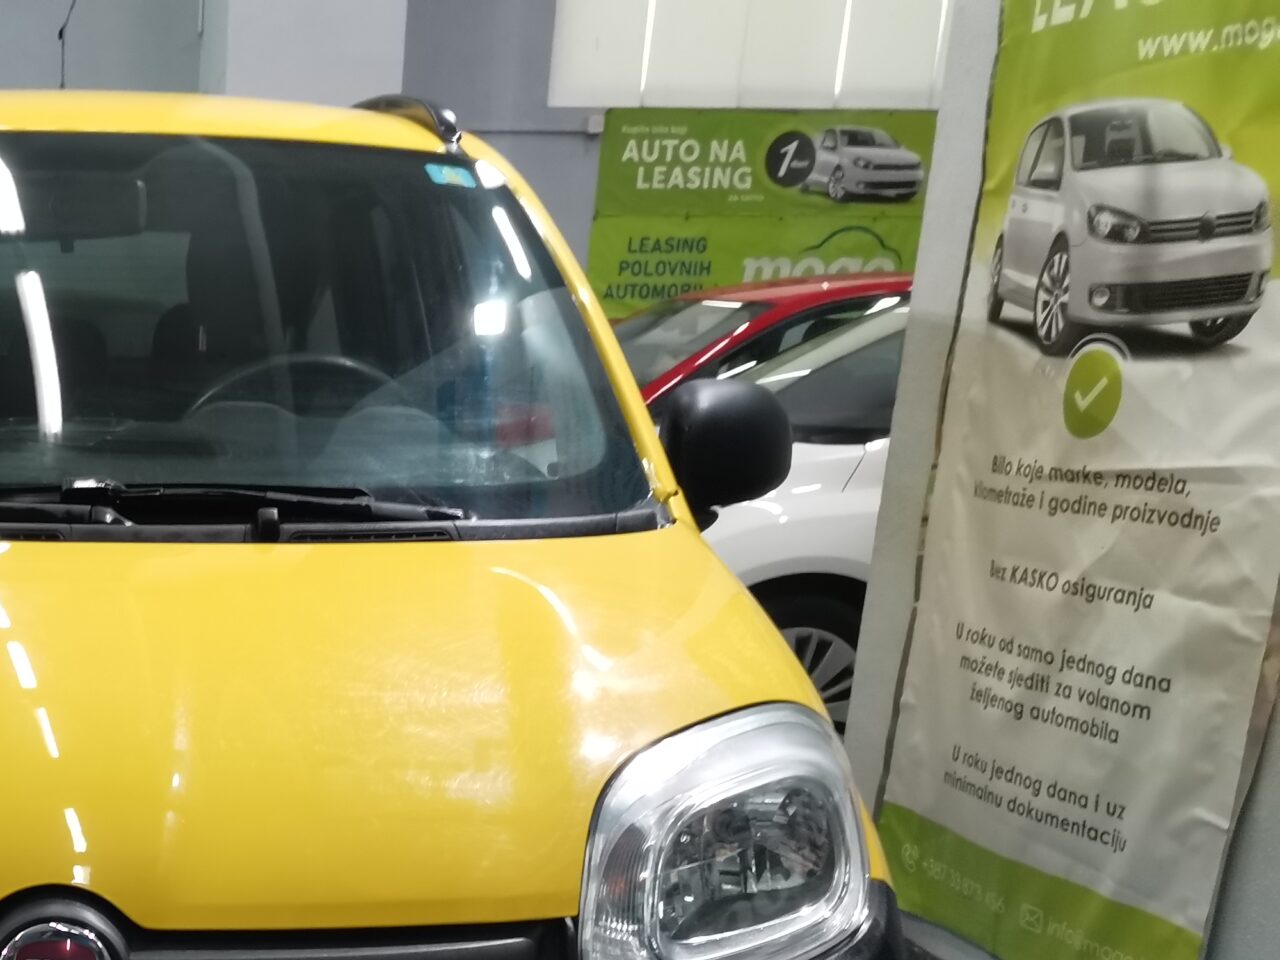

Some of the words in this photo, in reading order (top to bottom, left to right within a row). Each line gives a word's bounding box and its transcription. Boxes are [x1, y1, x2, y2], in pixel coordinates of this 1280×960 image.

[1137, 16, 1280, 61] www.mog
[621, 138, 701, 163] AUTO
[708, 138, 747, 163] NA
[777, 139, 800, 179] 1
[636, 165, 754, 190] LEASING
[627, 236, 708, 254] LEASING
[618, 260, 712, 277] POLOVNIH
[1015, 457, 1044, 484] koje
[1048, 465, 1109, 489] marke,
[1114, 471, 1191, 499] modela,
[1039, 490, 1046, 510] i
[1048, 494, 1108, 517] godine
[1110, 501, 1222, 538] proizvodnje
[1010, 564, 1059, 592] KASKO
[1061, 577, 1155, 613] osiguranja
[956, 622, 965, 640] U
[965, 627, 996, 649] roku
[999, 636, 1015, 655] od
[1017, 643, 1055, 665] samo
[1058, 648, 1117, 686] jednog
[1121, 665, 1172, 693] dana
[960, 655, 1006, 682] možete
[1007, 666, 1051, 693] sjediti
[1054, 682, 1072, 699] za
[1078, 687, 1152, 721] volanom
[970, 682, 1024, 721] željenog
[1029, 705, 1120, 744] automobila
[951, 744, 962, 763] U
[962, 752, 989, 774] roku
[989, 759, 1043, 798] jednog
[1046, 780, 1089, 809] dana
[1094, 793, 1100, 813] i
[1106, 801, 1127, 820] uz
[943, 770, 1004, 808] minimalnu
[1007, 797, 1127, 854] dokumentaciju
